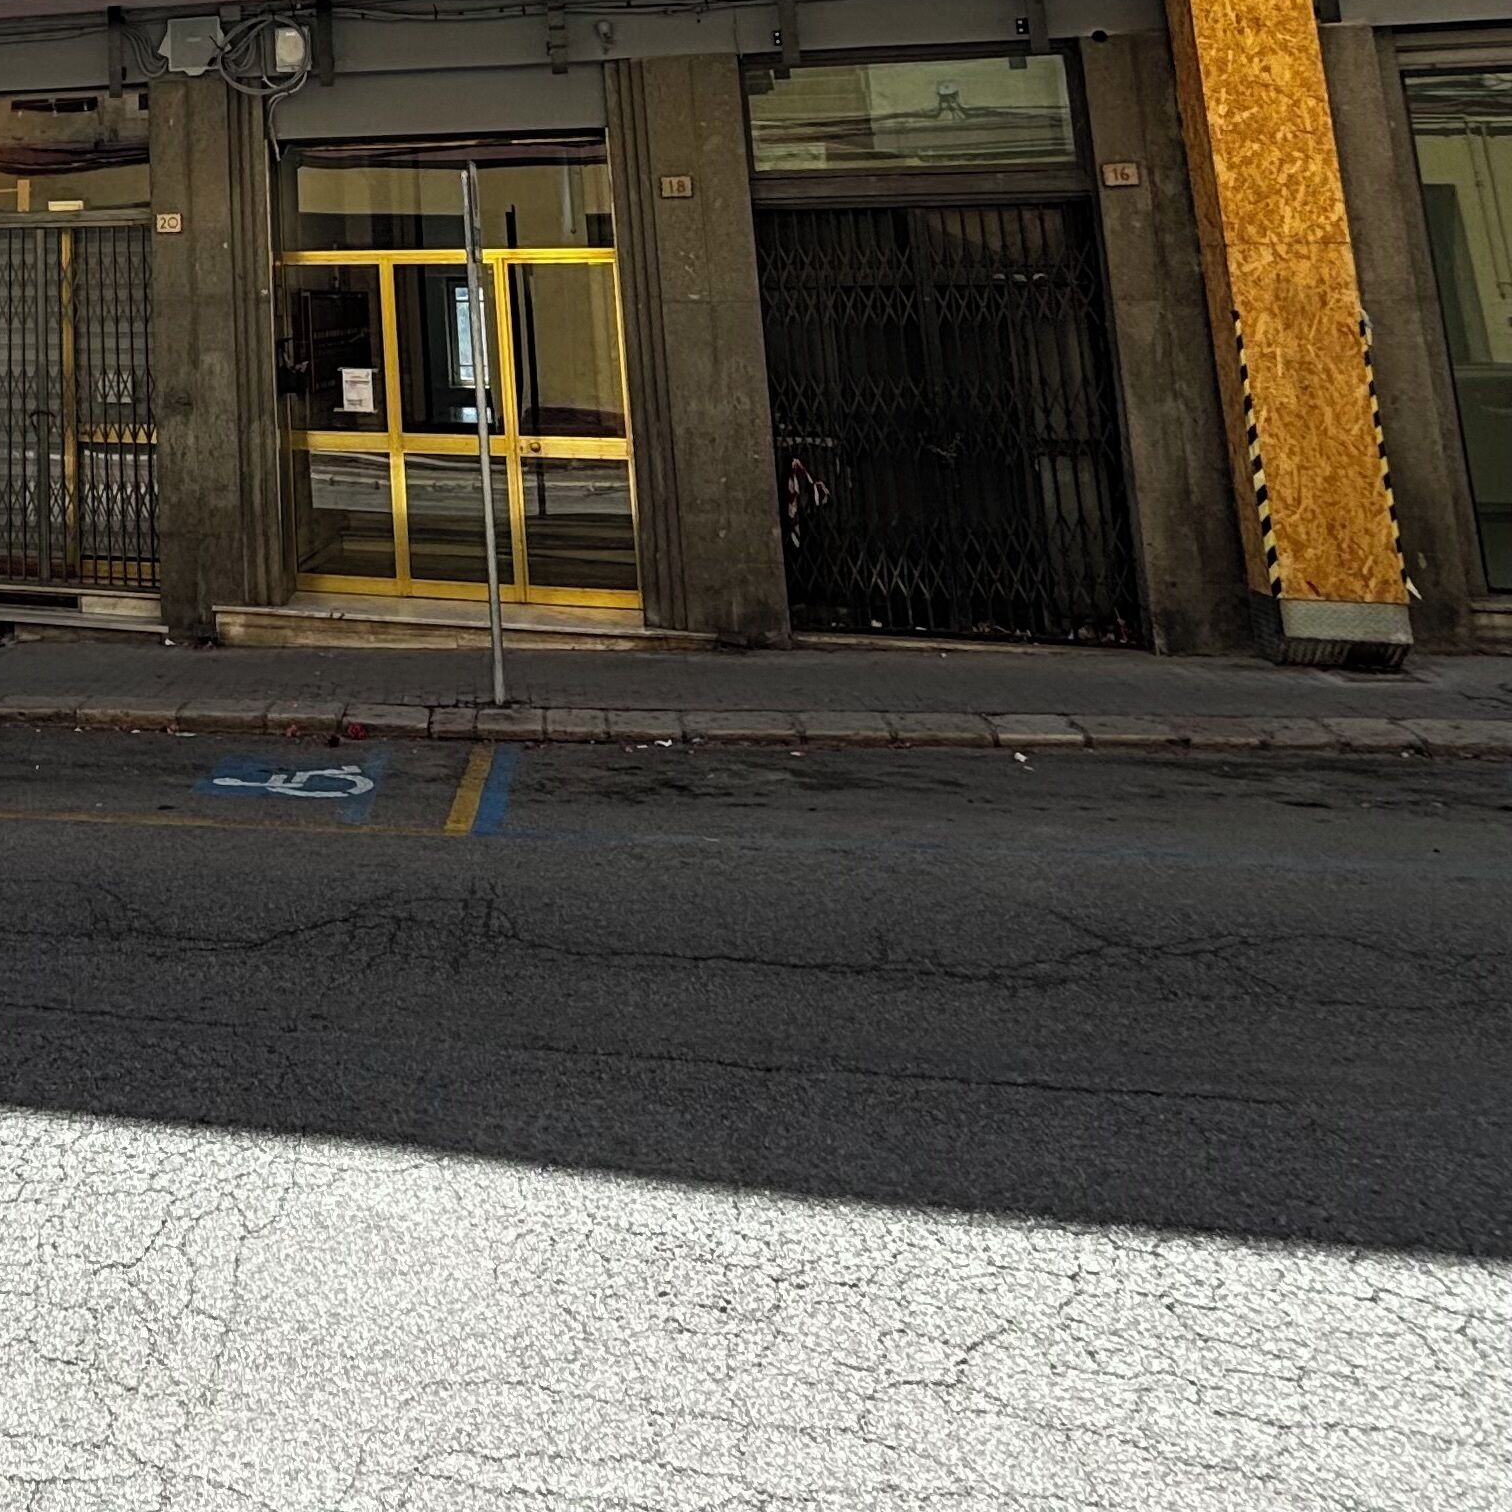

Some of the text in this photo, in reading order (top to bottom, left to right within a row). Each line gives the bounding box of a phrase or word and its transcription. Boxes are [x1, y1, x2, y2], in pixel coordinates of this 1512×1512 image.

[1111, 167, 1130, 182] 16
[668, 179, 686, 193] 18
[159, 216, 179, 230] 20
